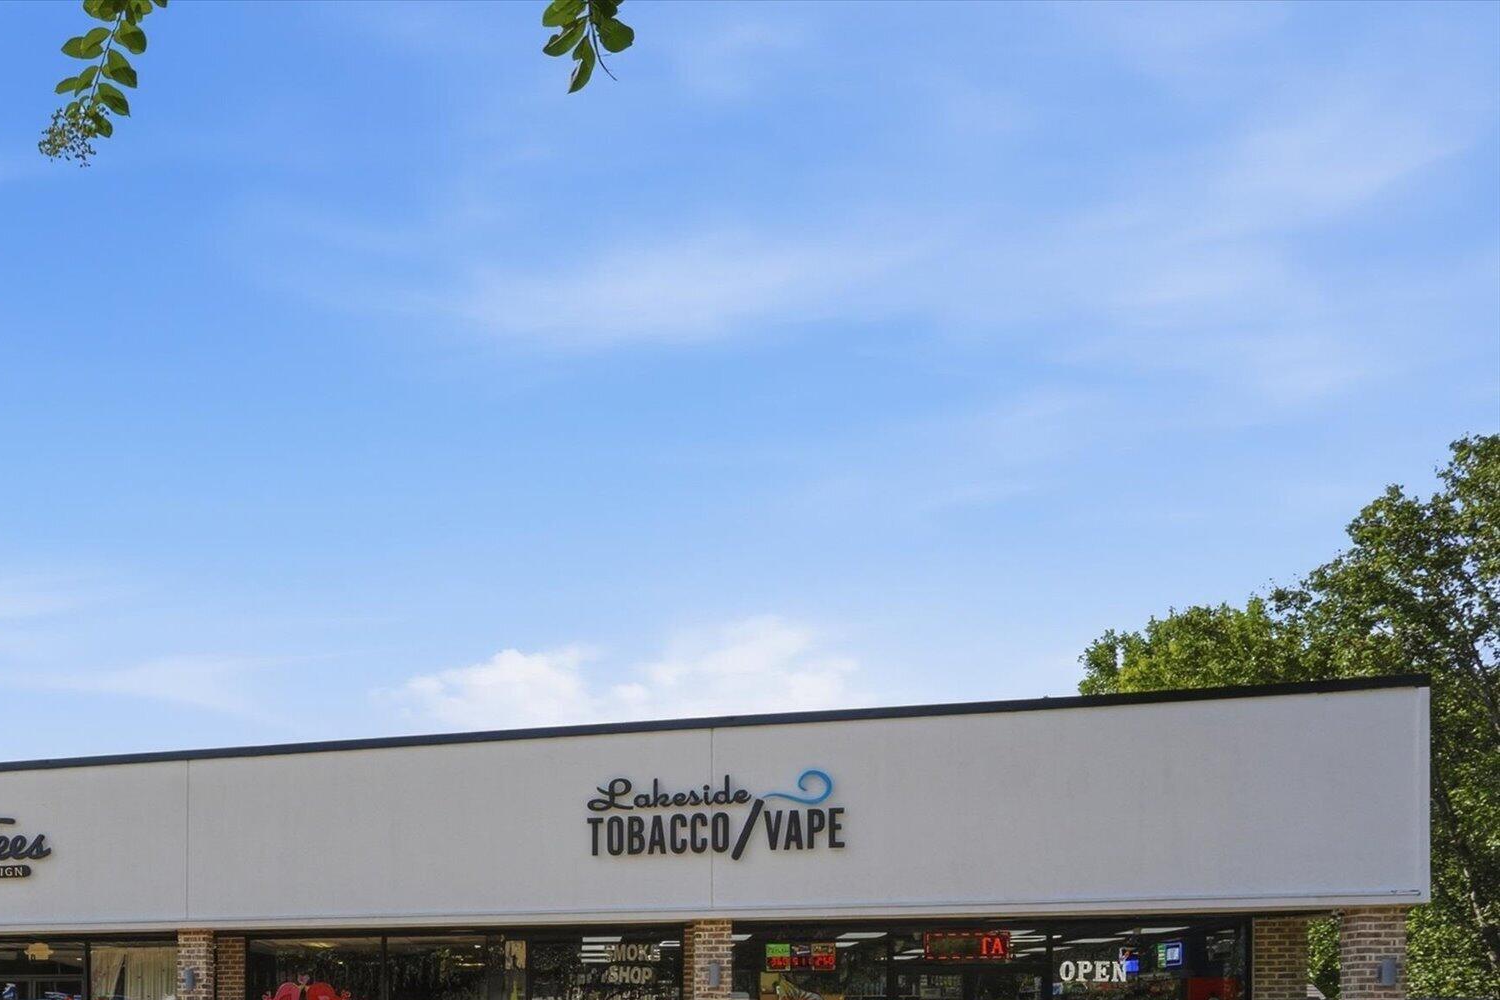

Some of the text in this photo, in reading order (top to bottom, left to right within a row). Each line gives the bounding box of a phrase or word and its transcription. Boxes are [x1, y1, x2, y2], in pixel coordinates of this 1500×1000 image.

[587, 774, 751, 812] Lakeside
[604, 944, 660, 962] SMOKE
[608, 965, 653, 984] SHOP
[1059, 960, 1127, 983] OPEN
